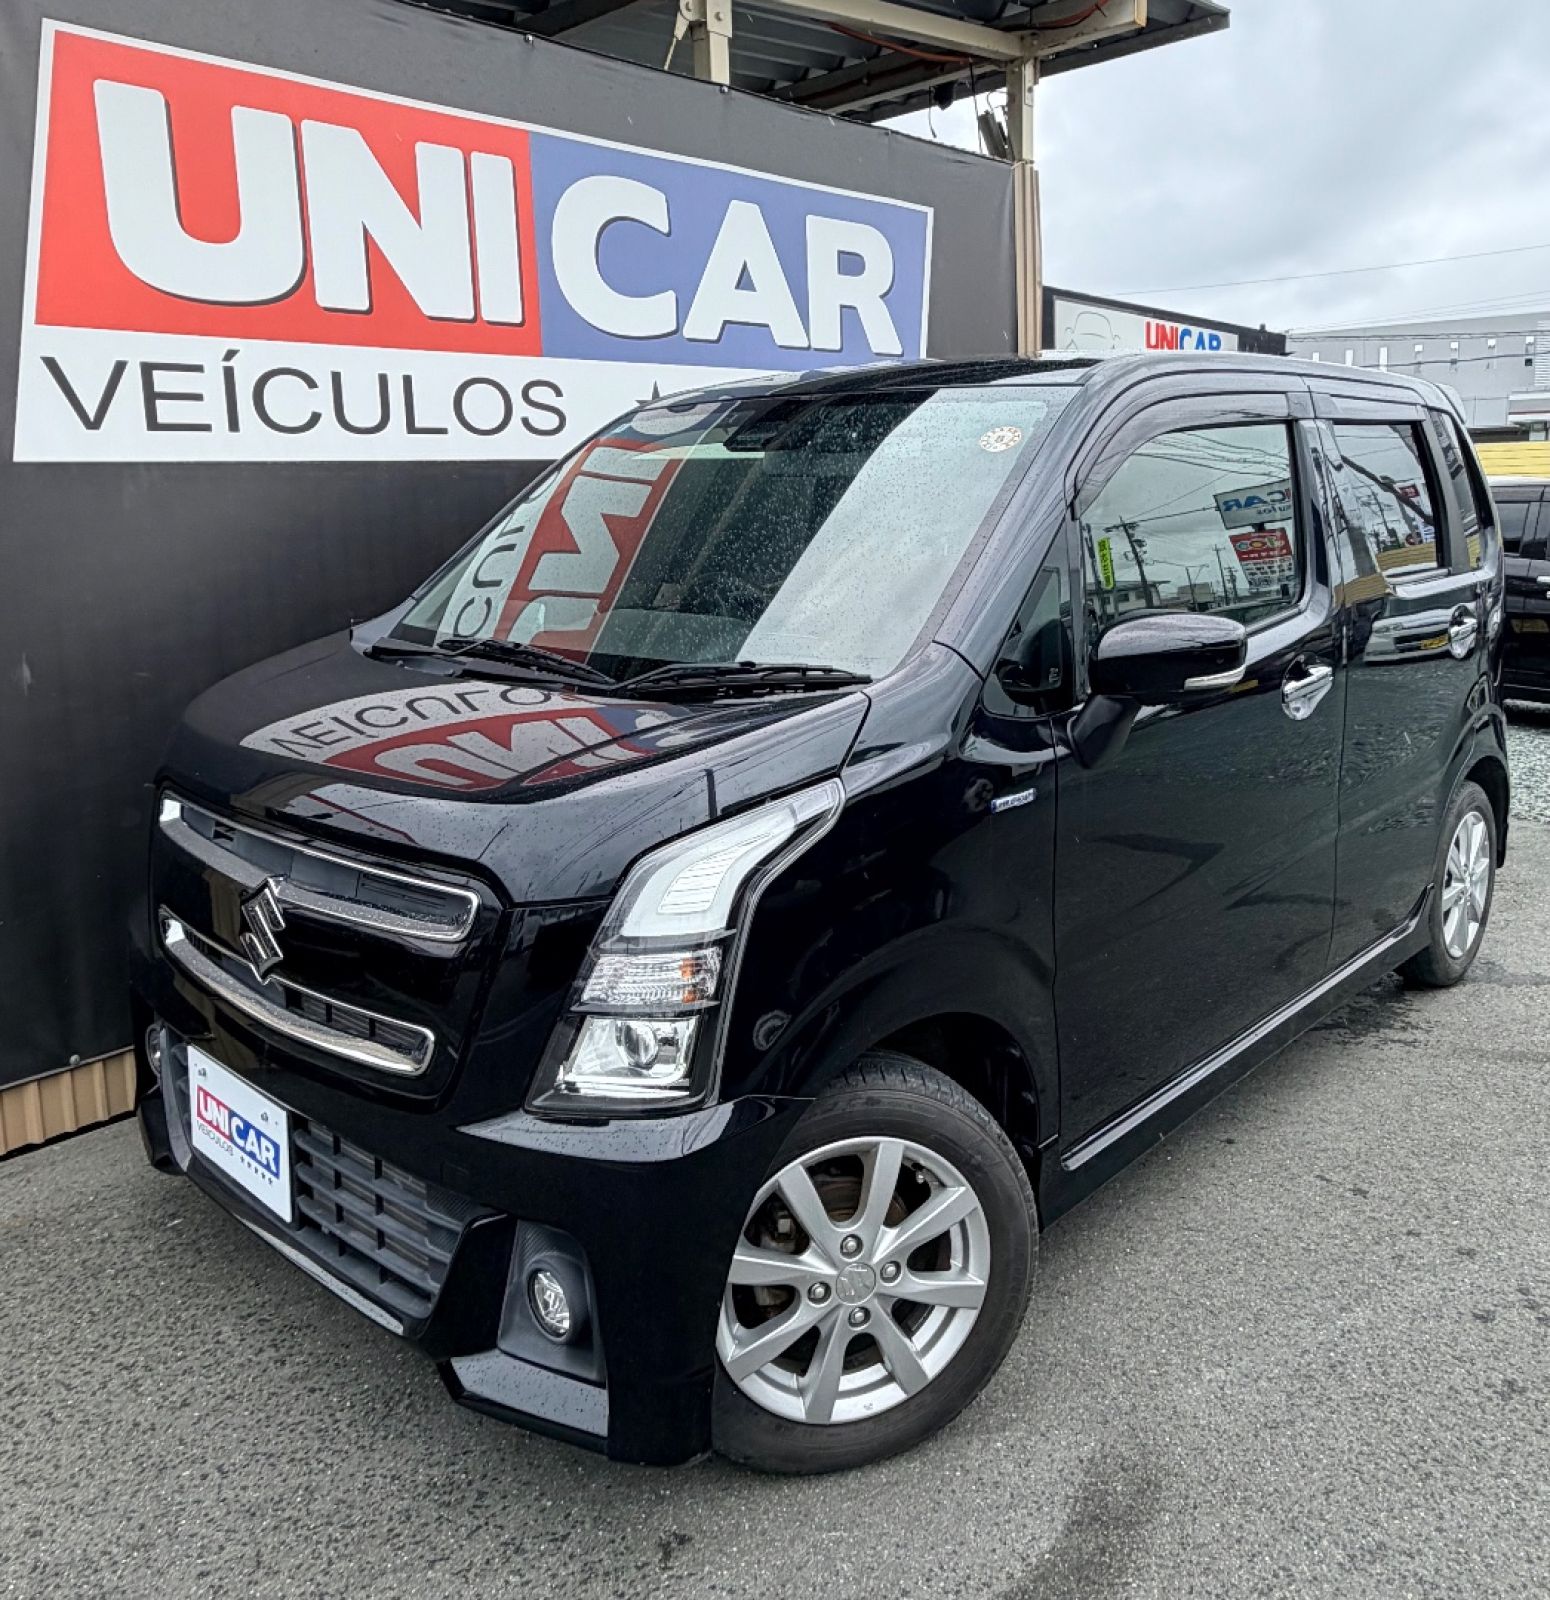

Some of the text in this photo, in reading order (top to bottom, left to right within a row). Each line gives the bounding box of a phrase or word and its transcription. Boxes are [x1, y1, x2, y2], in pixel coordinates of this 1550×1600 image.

[93, 79, 904, 356] UNICAR
[1145, 321, 1222, 350] UNICAR
[41, 349, 567, 437] VEÍCULOS
[200, 1091, 278, 1173] UNICAR
